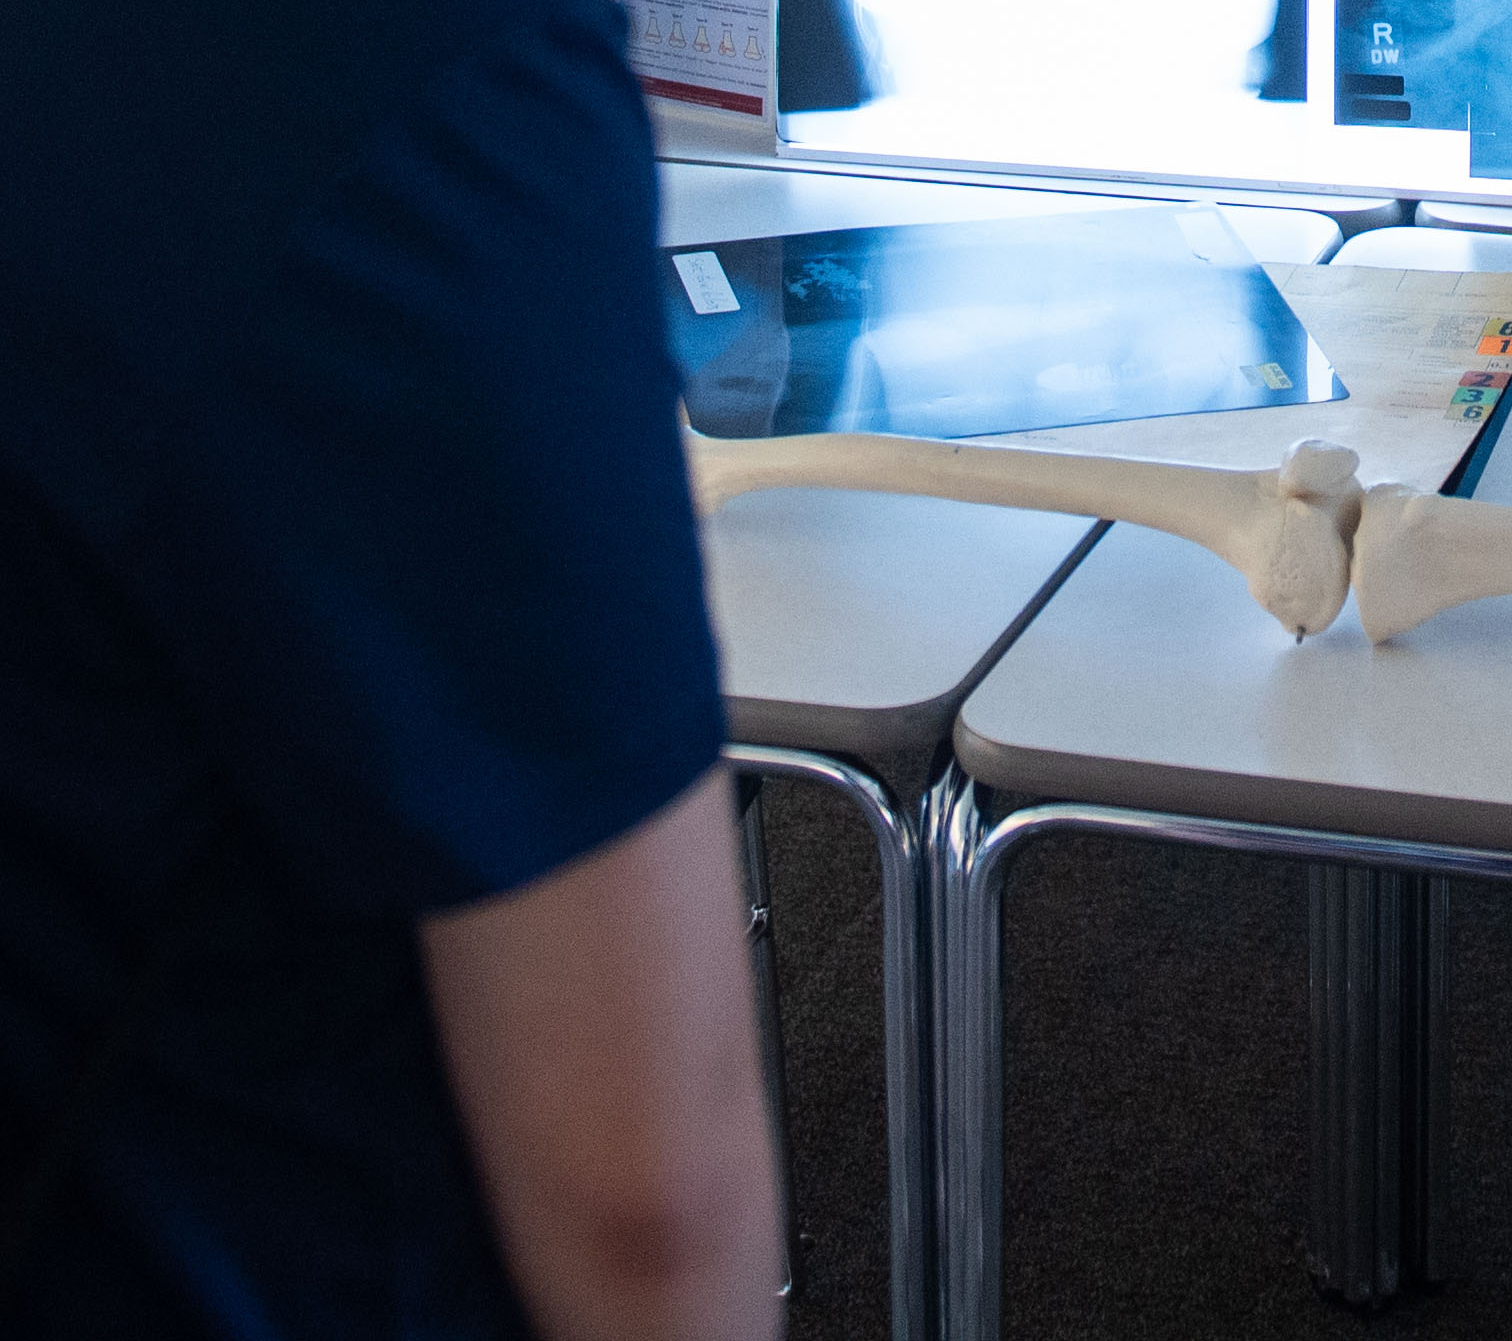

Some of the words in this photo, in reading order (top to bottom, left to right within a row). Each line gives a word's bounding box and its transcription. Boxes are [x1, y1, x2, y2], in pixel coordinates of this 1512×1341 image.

[1372, 22, 1394, 45] R
[1500, 339, 1512, 354] 1
[1468, 373, 1495, 387] 2
[1460, 388, 1485, 403] 3
[1463, 405, 1485, 420] 6
